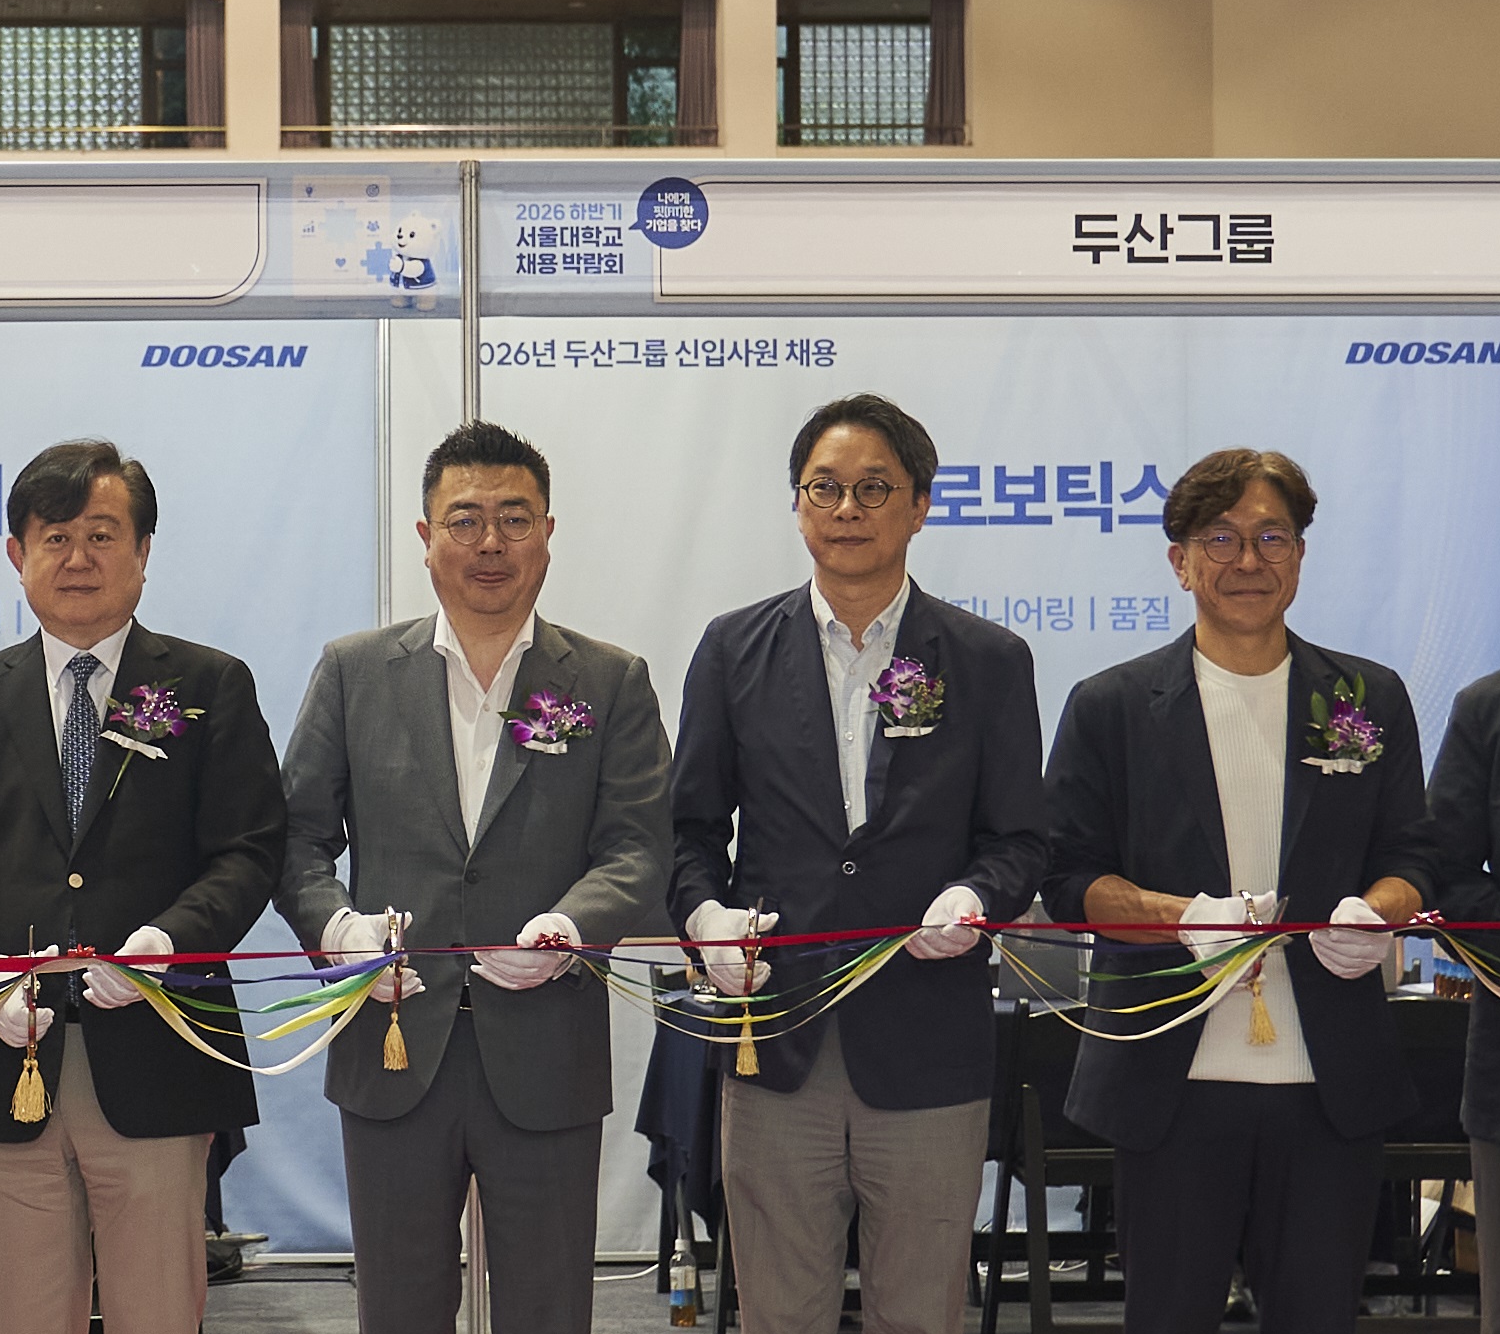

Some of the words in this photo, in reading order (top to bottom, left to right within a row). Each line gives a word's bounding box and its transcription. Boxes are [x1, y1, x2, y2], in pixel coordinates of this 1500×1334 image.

[516, 204, 565, 220] 2026
[570, 203, 621, 220] 하반기
[517, 226, 623, 247] 서울대학교
[1073, 214, 1274, 264] 두산그룹
[516, 253, 557, 274] 채용
[563, 253, 623, 274] 박람회
[141, 346, 308, 367] DOOSAN
[564, 339, 668, 368] 두산그룹
[675, 339, 778, 367] 신입사원
[786, 339, 837, 367] 채용
[1109, 596, 1170, 631] 품질
